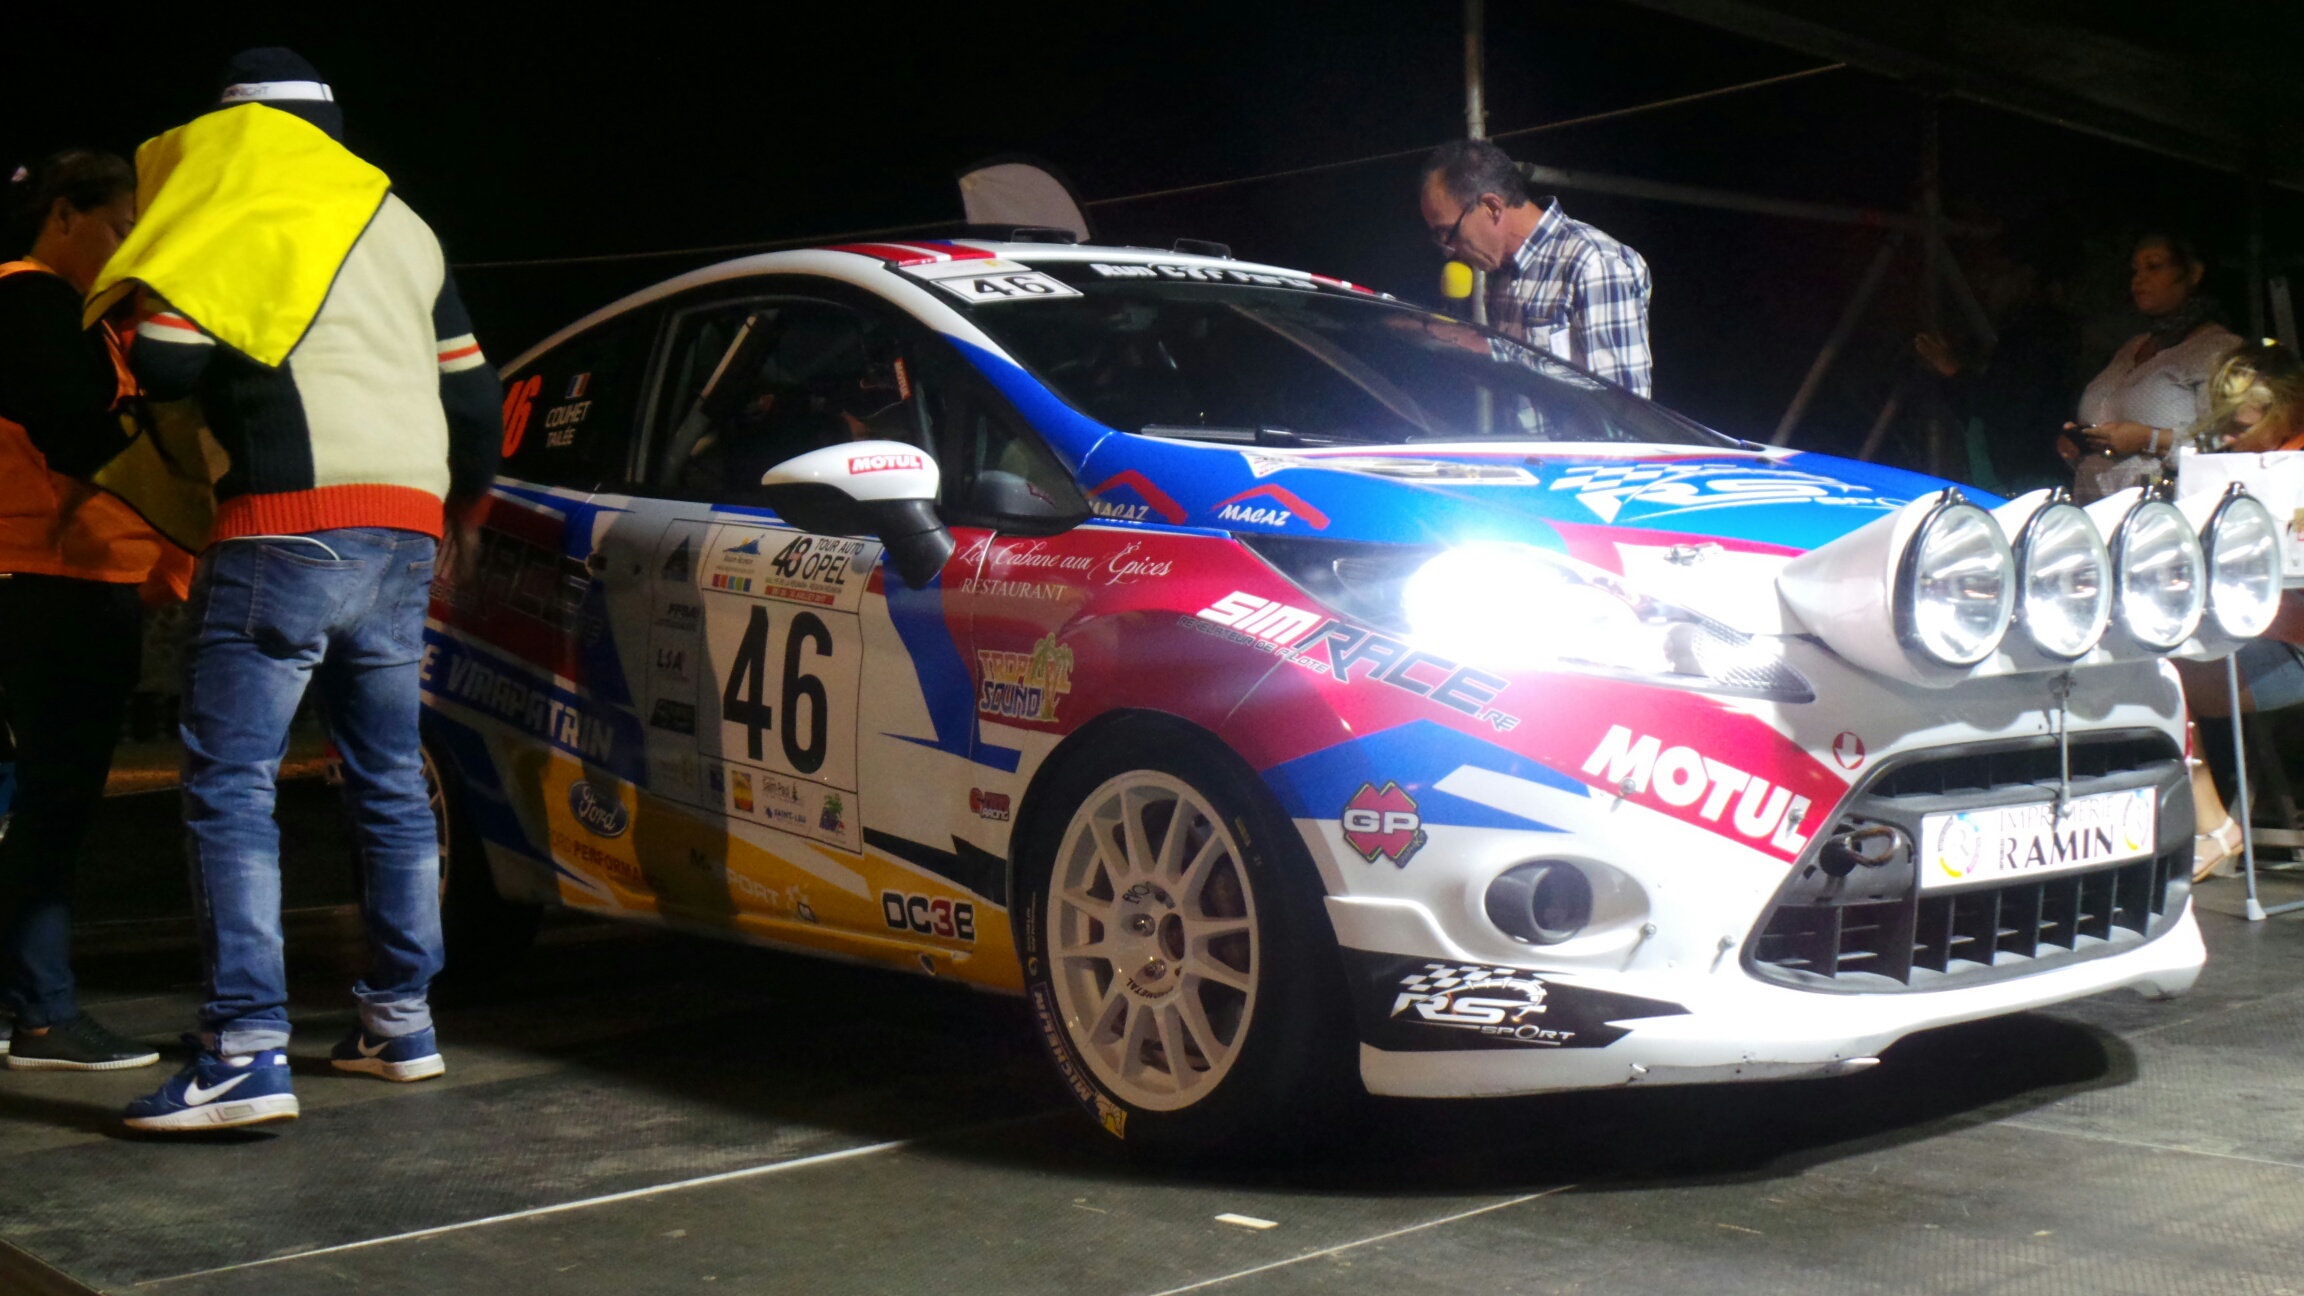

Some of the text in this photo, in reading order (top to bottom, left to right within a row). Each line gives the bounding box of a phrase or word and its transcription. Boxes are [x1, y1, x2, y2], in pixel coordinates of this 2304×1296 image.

[973, 276, 1056, 296] 46
[851, 454, 921, 472] MOTUL
[1218, 504, 1291, 527] MACAZ
[1576, 479, 1829, 523] RS
[814, 538, 865, 556] TOUR AUTO
[995, 539, 1060, 567] Cabane
[1060, 555, 1094, 571] aux
[1103, 540, 1173, 586] Épices
[801, 552, 849, 585] OPEL
[961, 577, 1067, 601] RESTAURANT
[1178, 616, 1331, 674] REVELATEUR DE PLOTE
[723, 605, 833, 774] 46
[979, 680, 1044, 719] SOUND
[447, 654, 614, 763] VIRAPATRIN
[1581, 723, 1812, 855] MOTUL
[578, 786, 617, 831] Ford
[1343, 809, 1419, 834] GP
[2000, 796, 2114, 832] IMPRERIE
[2000, 824, 2114, 870] RAMIN
[1391, 992, 1520, 1024] RS
[1480, 1024, 1575, 1041] SPORT
